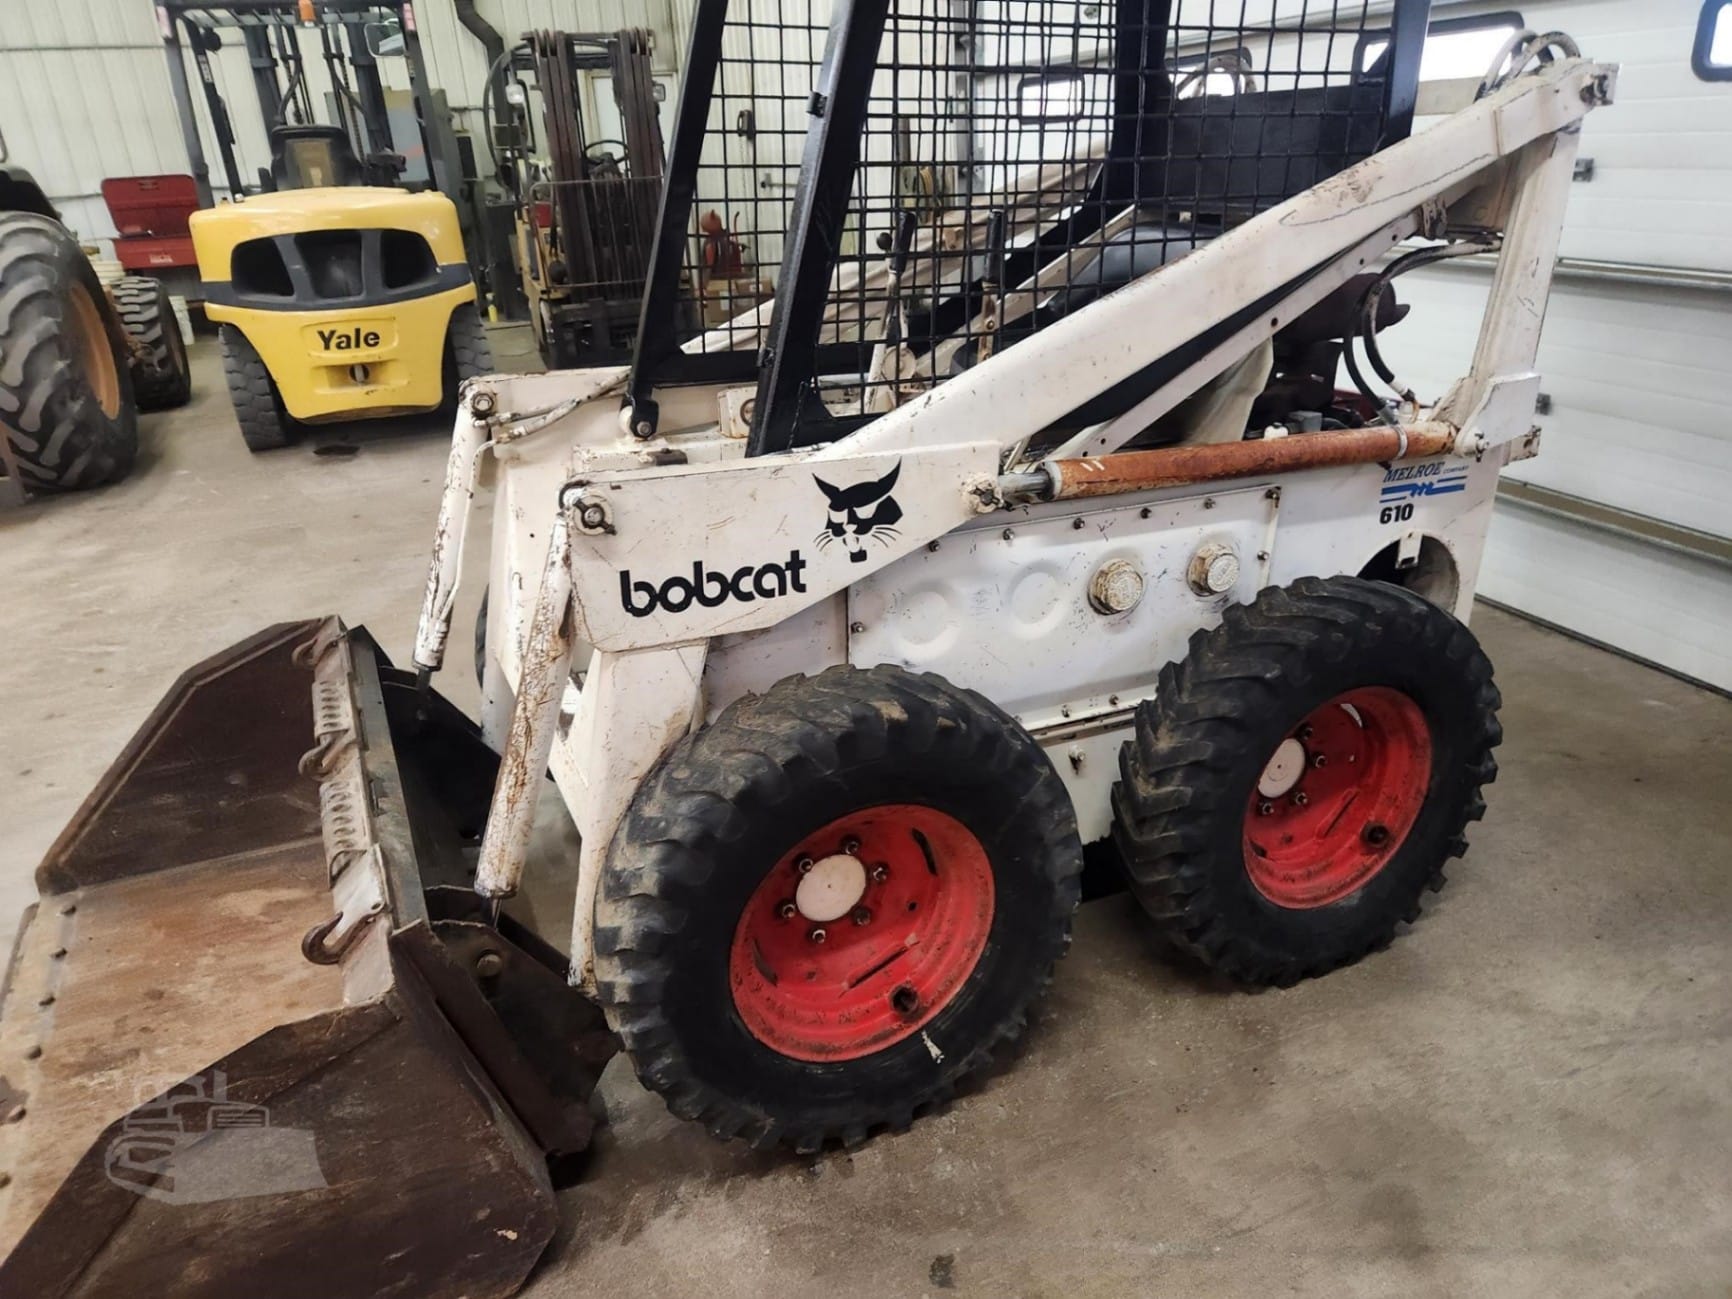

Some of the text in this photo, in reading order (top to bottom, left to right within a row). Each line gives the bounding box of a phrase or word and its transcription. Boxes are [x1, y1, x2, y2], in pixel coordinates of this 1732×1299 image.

[317, 327, 380, 351] Yale
[1383, 461, 1445, 483] MELROE
[1380, 503, 1414, 524] 610
[619, 550, 806, 617] bobcat
